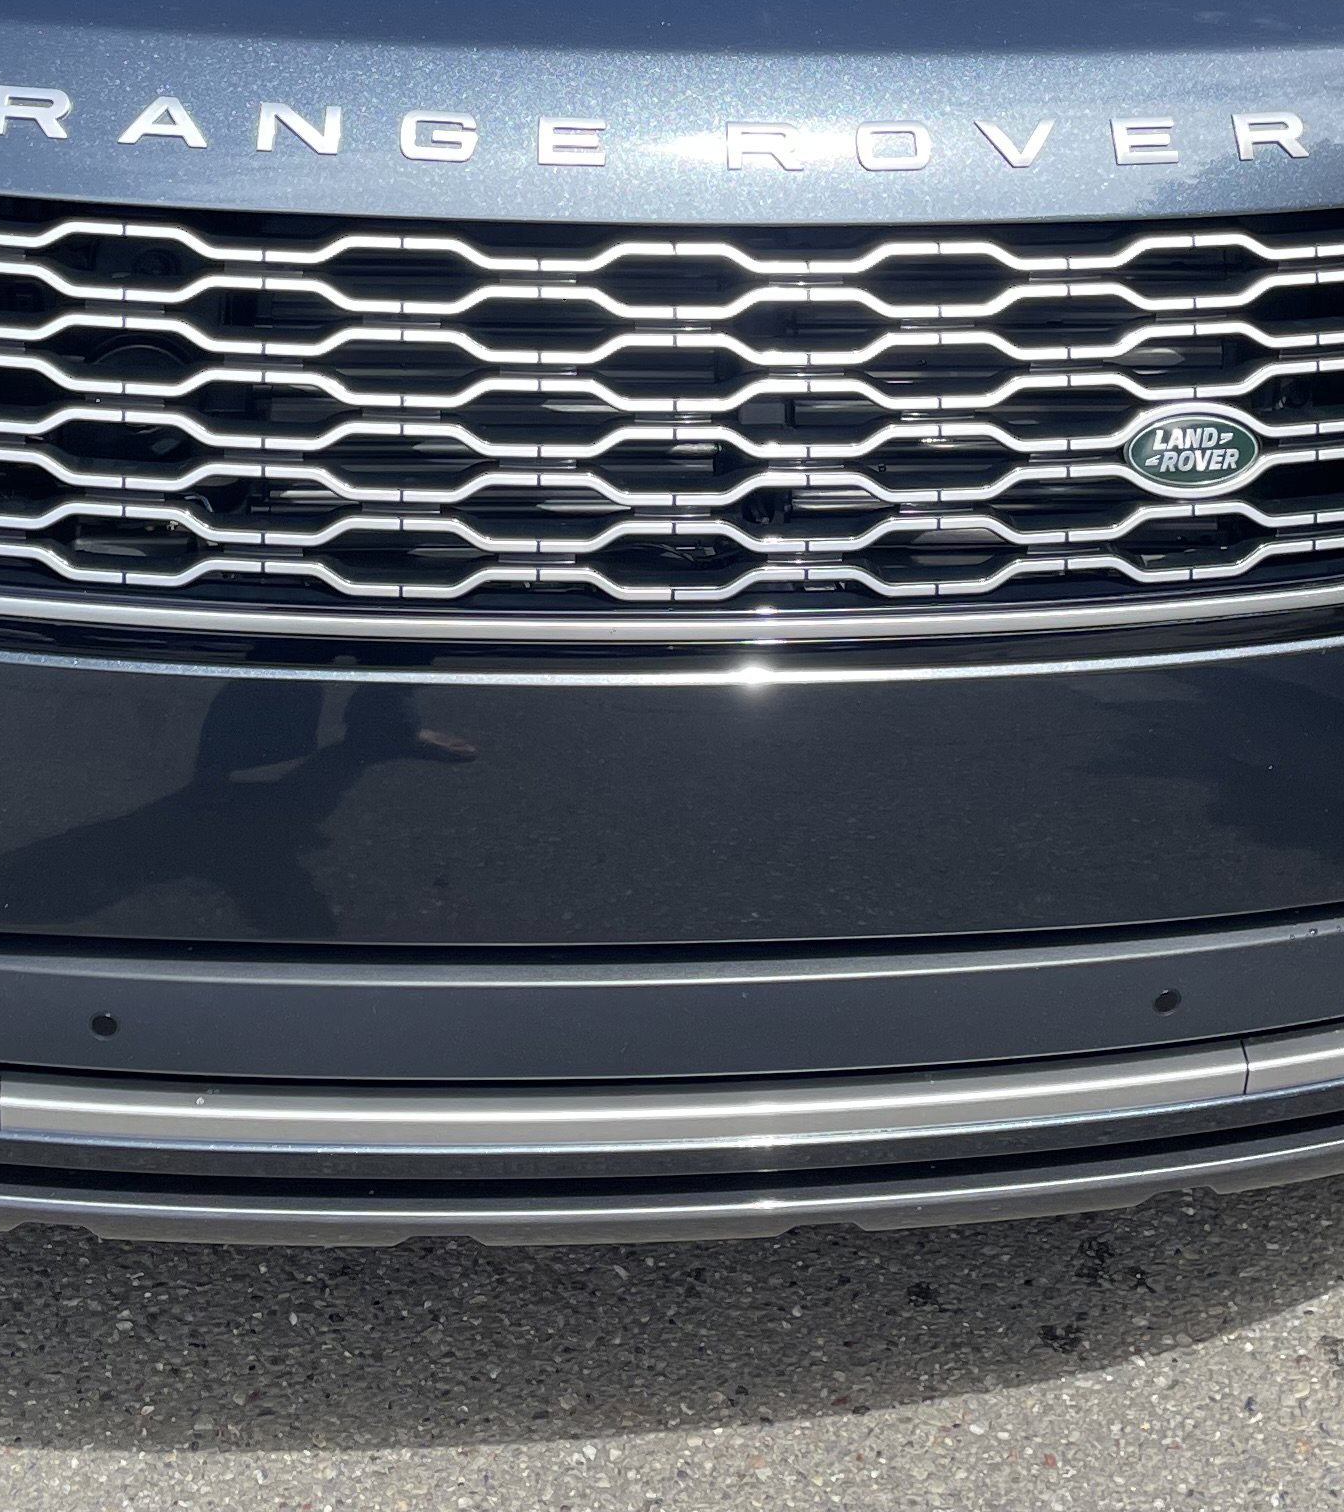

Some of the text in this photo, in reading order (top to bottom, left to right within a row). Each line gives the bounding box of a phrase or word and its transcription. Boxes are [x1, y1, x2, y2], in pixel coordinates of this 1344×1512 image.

[725, 110, 1311, 172] ROVER
[1152, 427, 1218, 451] LAND
[1159, 448, 1240, 473] ROVER
